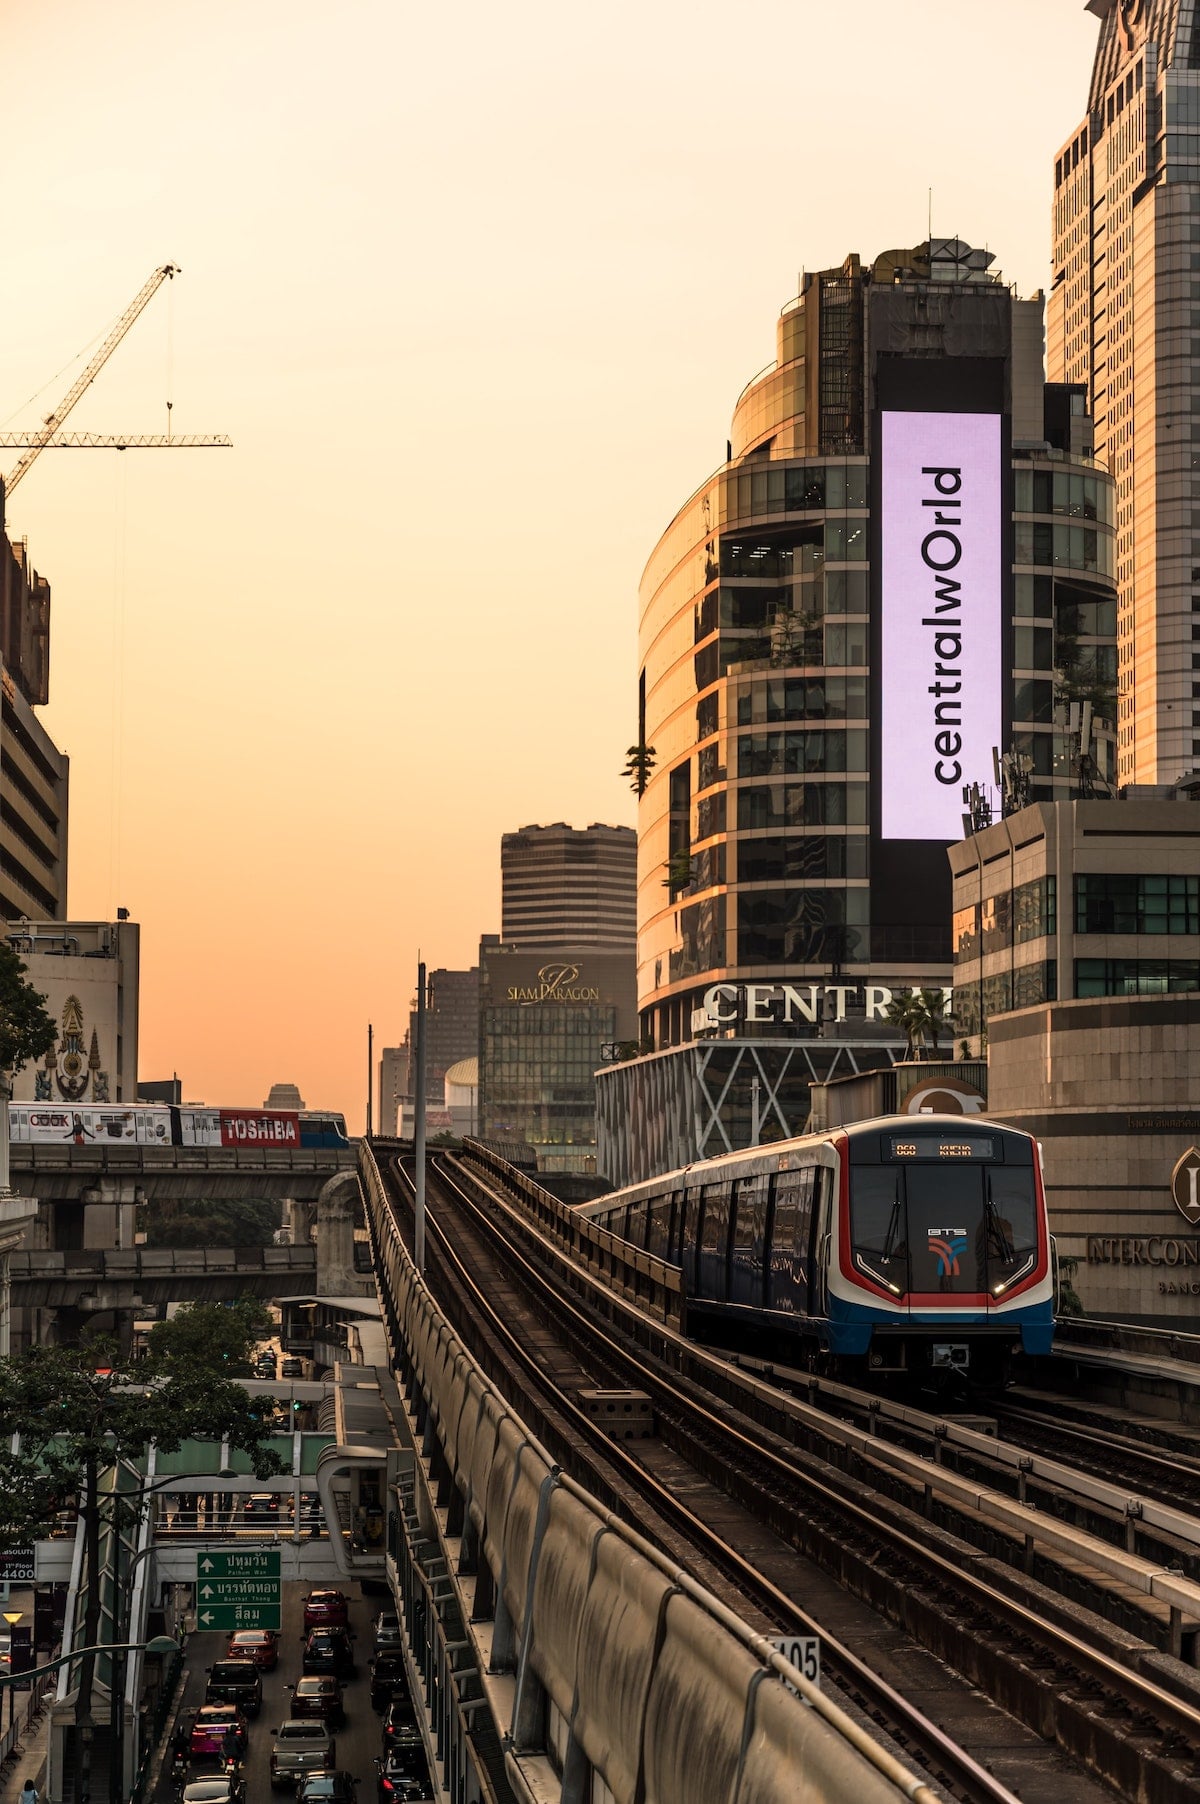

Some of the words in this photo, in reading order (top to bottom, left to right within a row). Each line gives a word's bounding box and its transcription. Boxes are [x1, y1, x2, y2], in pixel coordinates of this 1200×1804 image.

[921, 466, 962, 785] centralwOrld
[507, 986, 538, 1000] SIAM
[540, 983, 599, 1000] PARAGON
[224, 1118, 296, 1140] TOSHIBA
[928, 1228, 967, 1236] BTS
[227, 1553, 267, 1570] ปทุมวัน
[217, 1580, 277, 1593] บรรทัดทอง
[235, 1605, 260, 1620] สีลม
